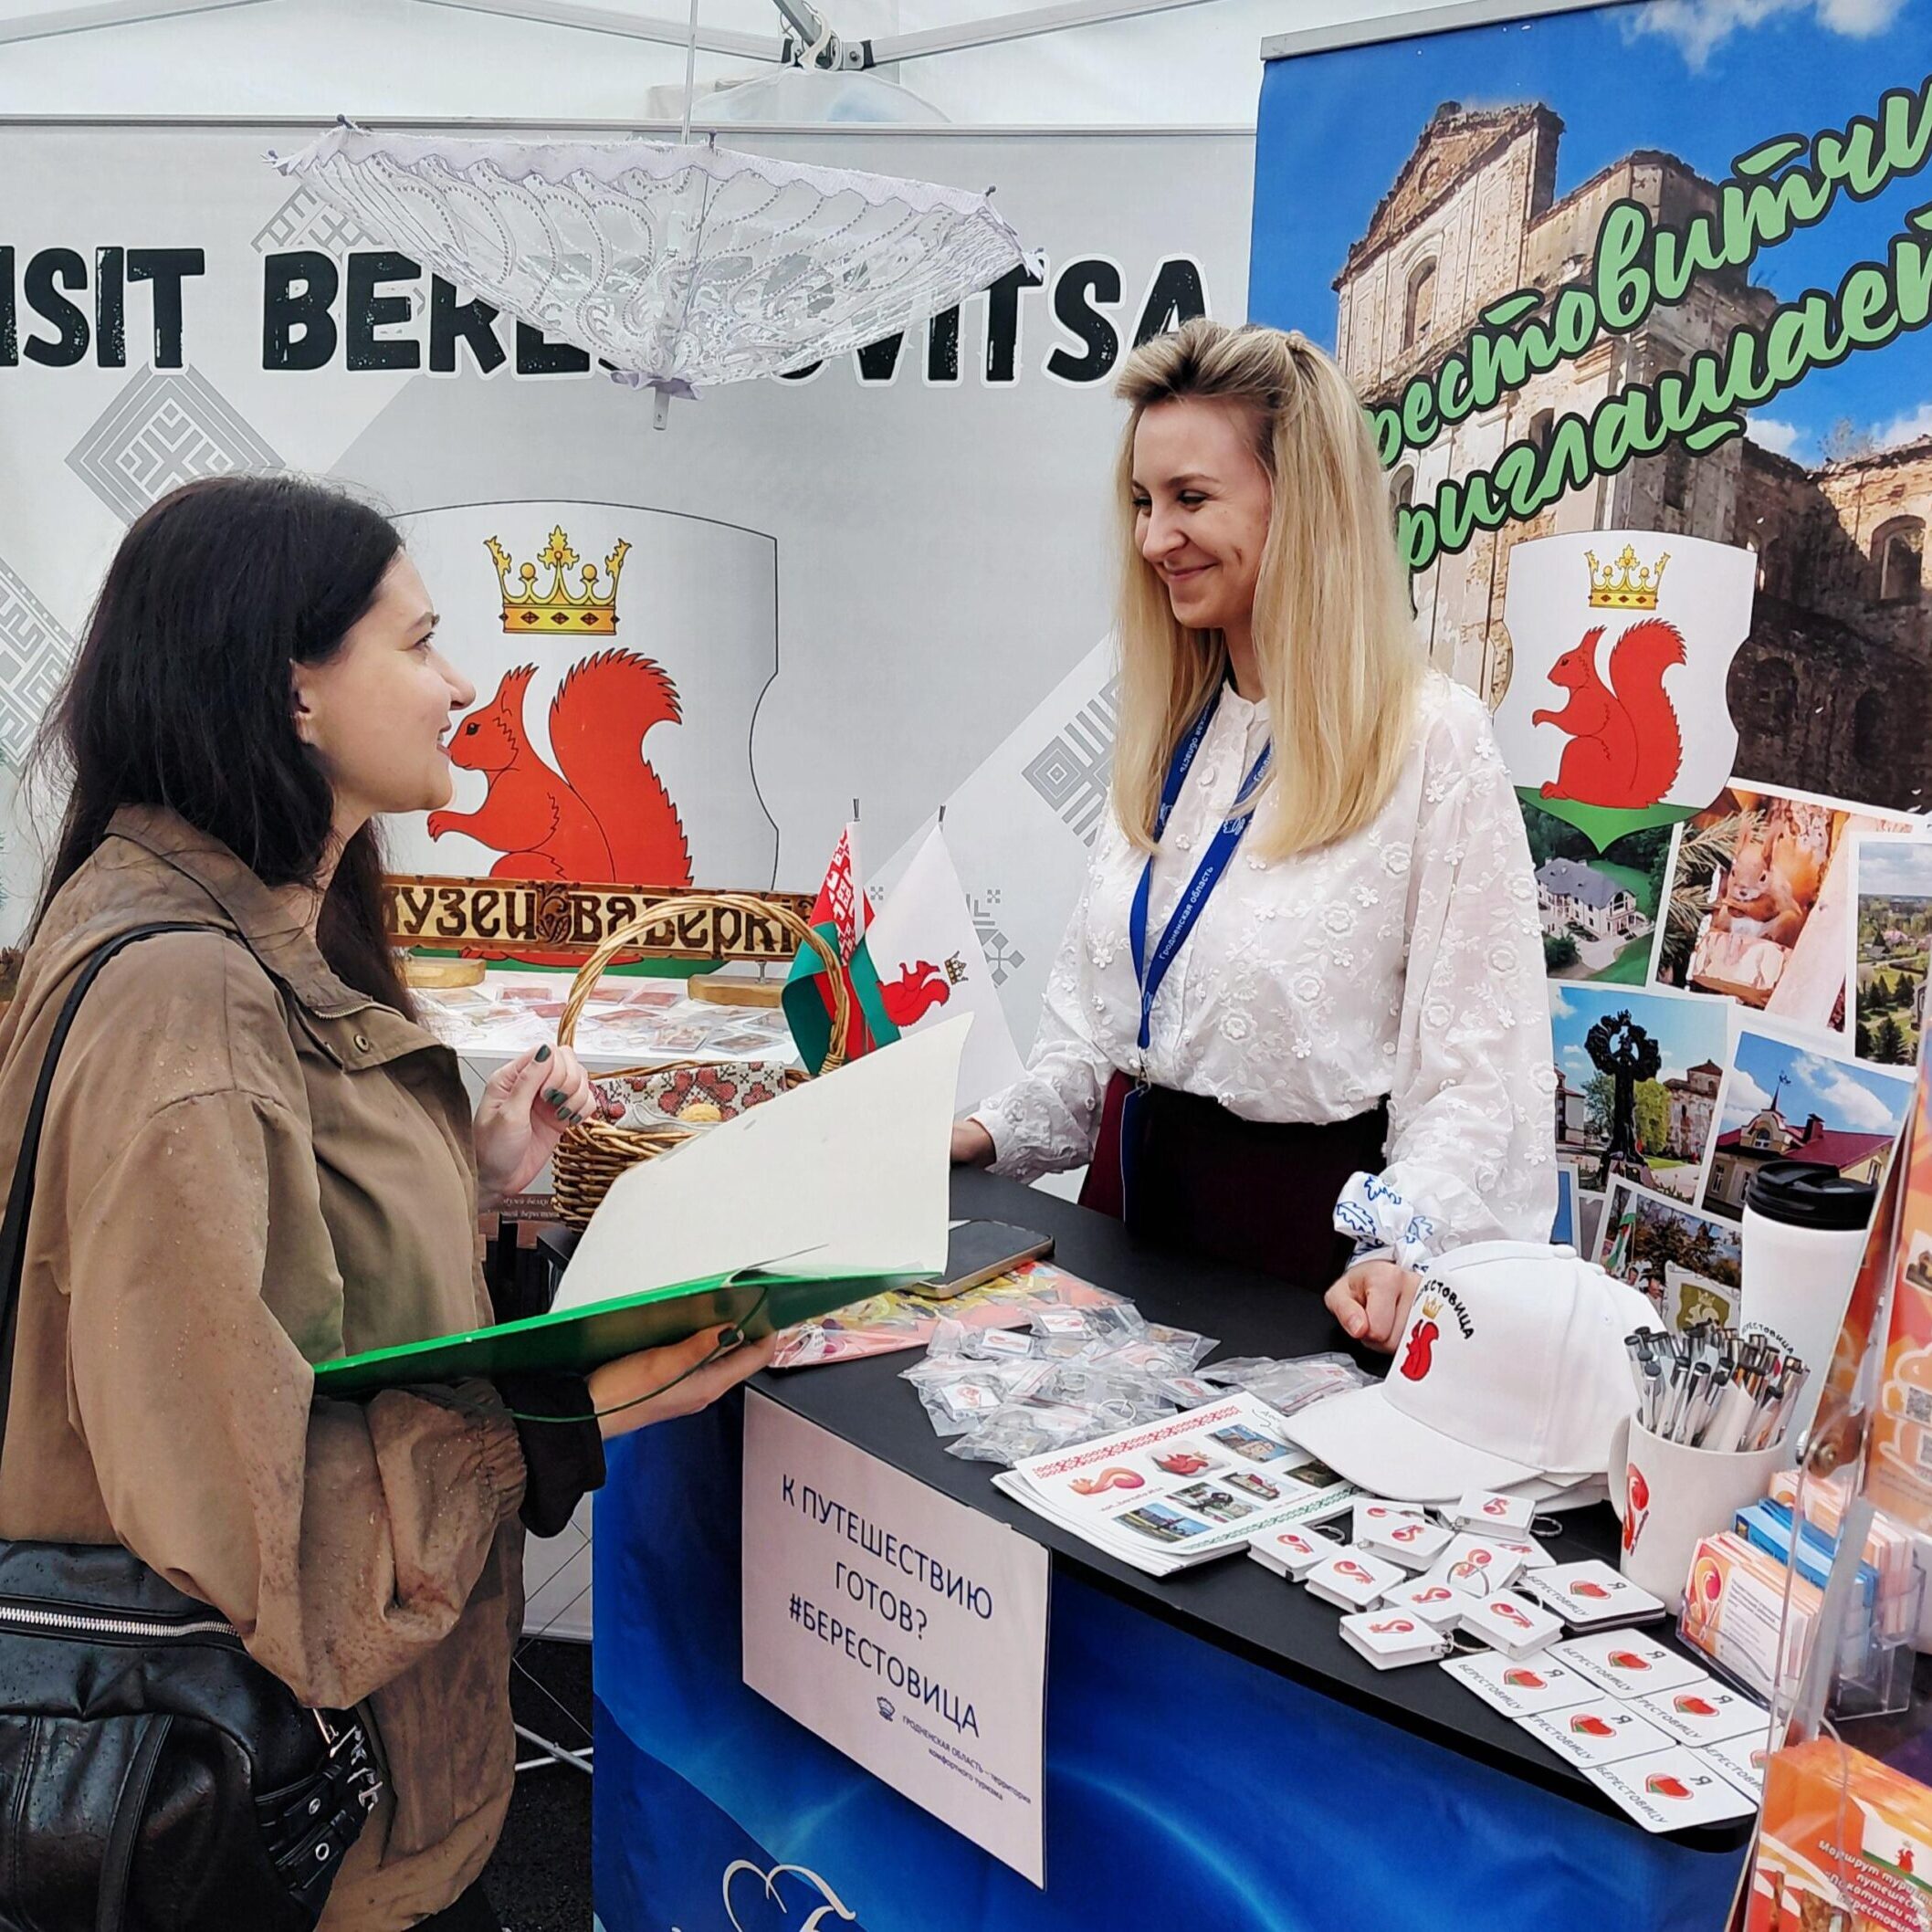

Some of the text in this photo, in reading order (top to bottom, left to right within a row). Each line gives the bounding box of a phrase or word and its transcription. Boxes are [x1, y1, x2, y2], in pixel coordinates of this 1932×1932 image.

[1363, 78, 1932, 467] рестовитчи
[1160, 866, 1214, 961] Гродненская область
[782, 1473, 992, 1621] К ПУТЕШЕСТВИЮ
[835, 1560, 929, 1641] ГОТОВ?
[789, 1592, 980, 1738] #БЕРЕСТОВИЦА
[1457, 1663, 1525, 1710] БЕРЕСТОВИЦУ
[1528, 1713, 1596, 1759] ЕРЕСТОВИЦУ
[1634, 1696, 1703, 1738] ЕРЕСТОВИЦУ
[951, 1747, 984, 1774] ОБЛАСТЬ
[1596, 1766, 1668, 1823] БЕРЕСТОВИЦУ
